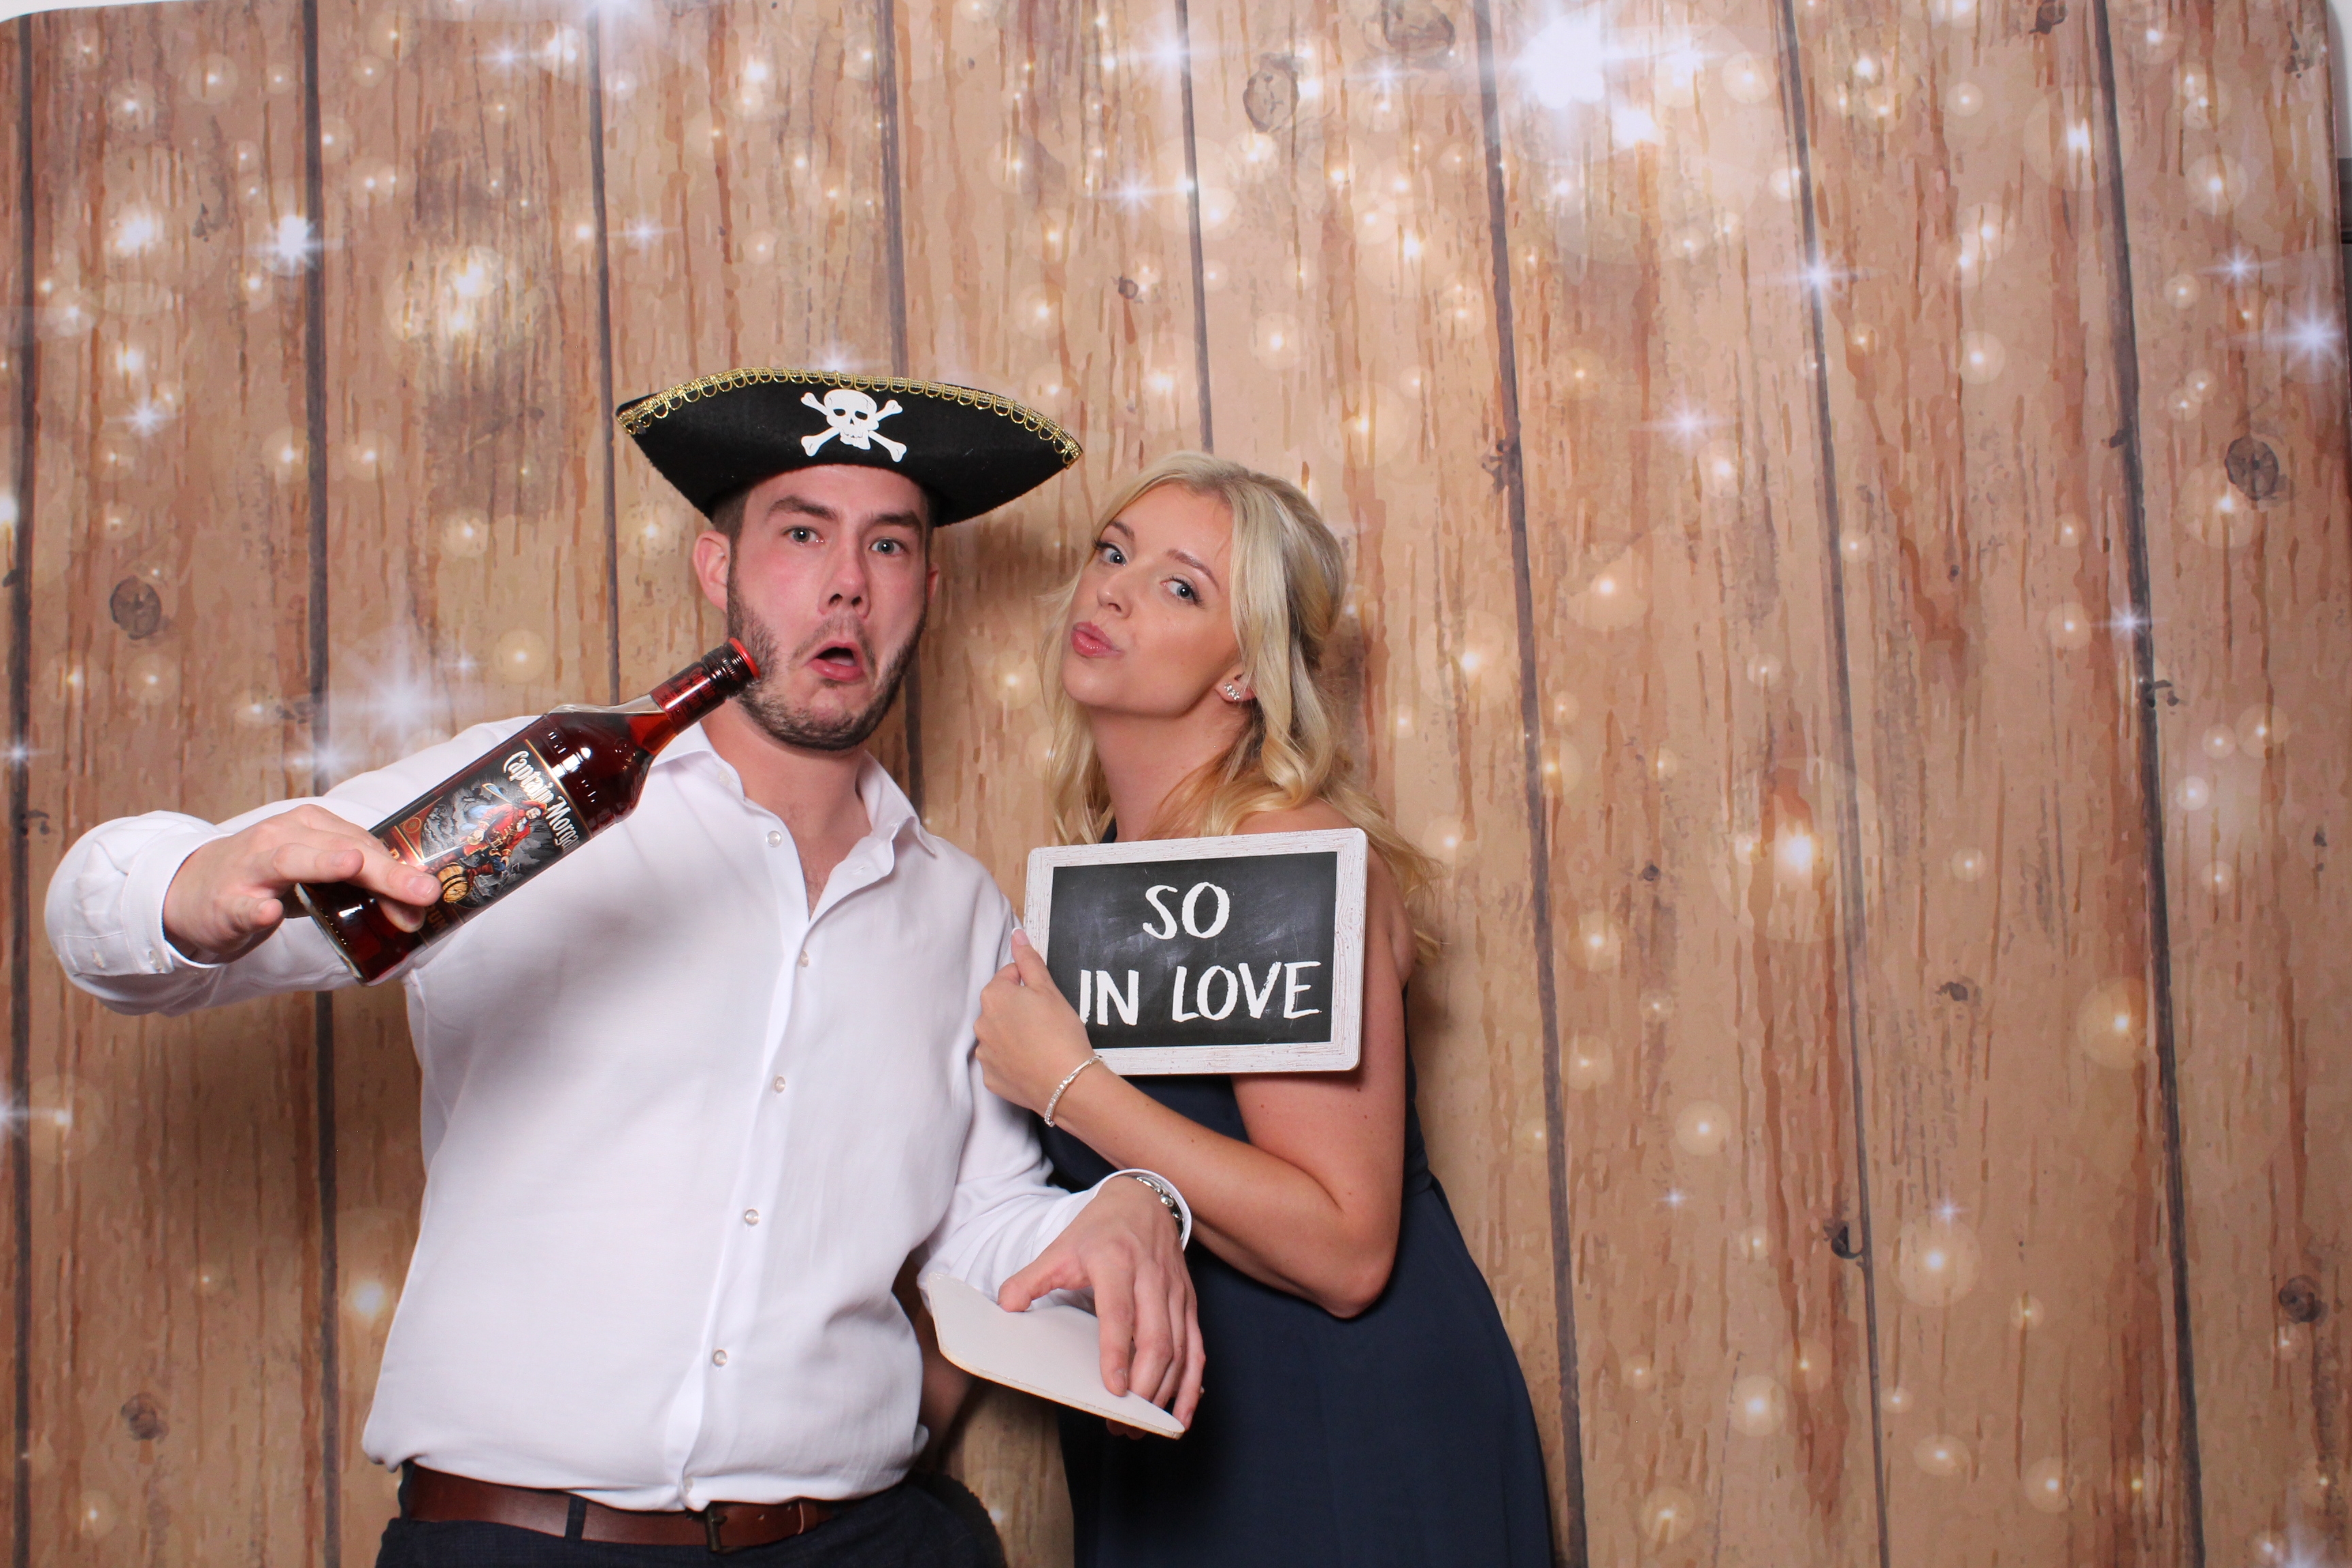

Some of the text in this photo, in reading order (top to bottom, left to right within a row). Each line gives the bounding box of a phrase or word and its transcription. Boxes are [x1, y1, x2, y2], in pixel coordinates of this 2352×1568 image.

[673, 676, 702, 709] Mogan
[688, 666, 716, 700] Capain
[504, 750, 555, 804] Captain
[545, 796, 579, 851] Morgan
[1143, 881, 1230, 941] SO
[1079, 960, 1322, 1026] IN LOVE
